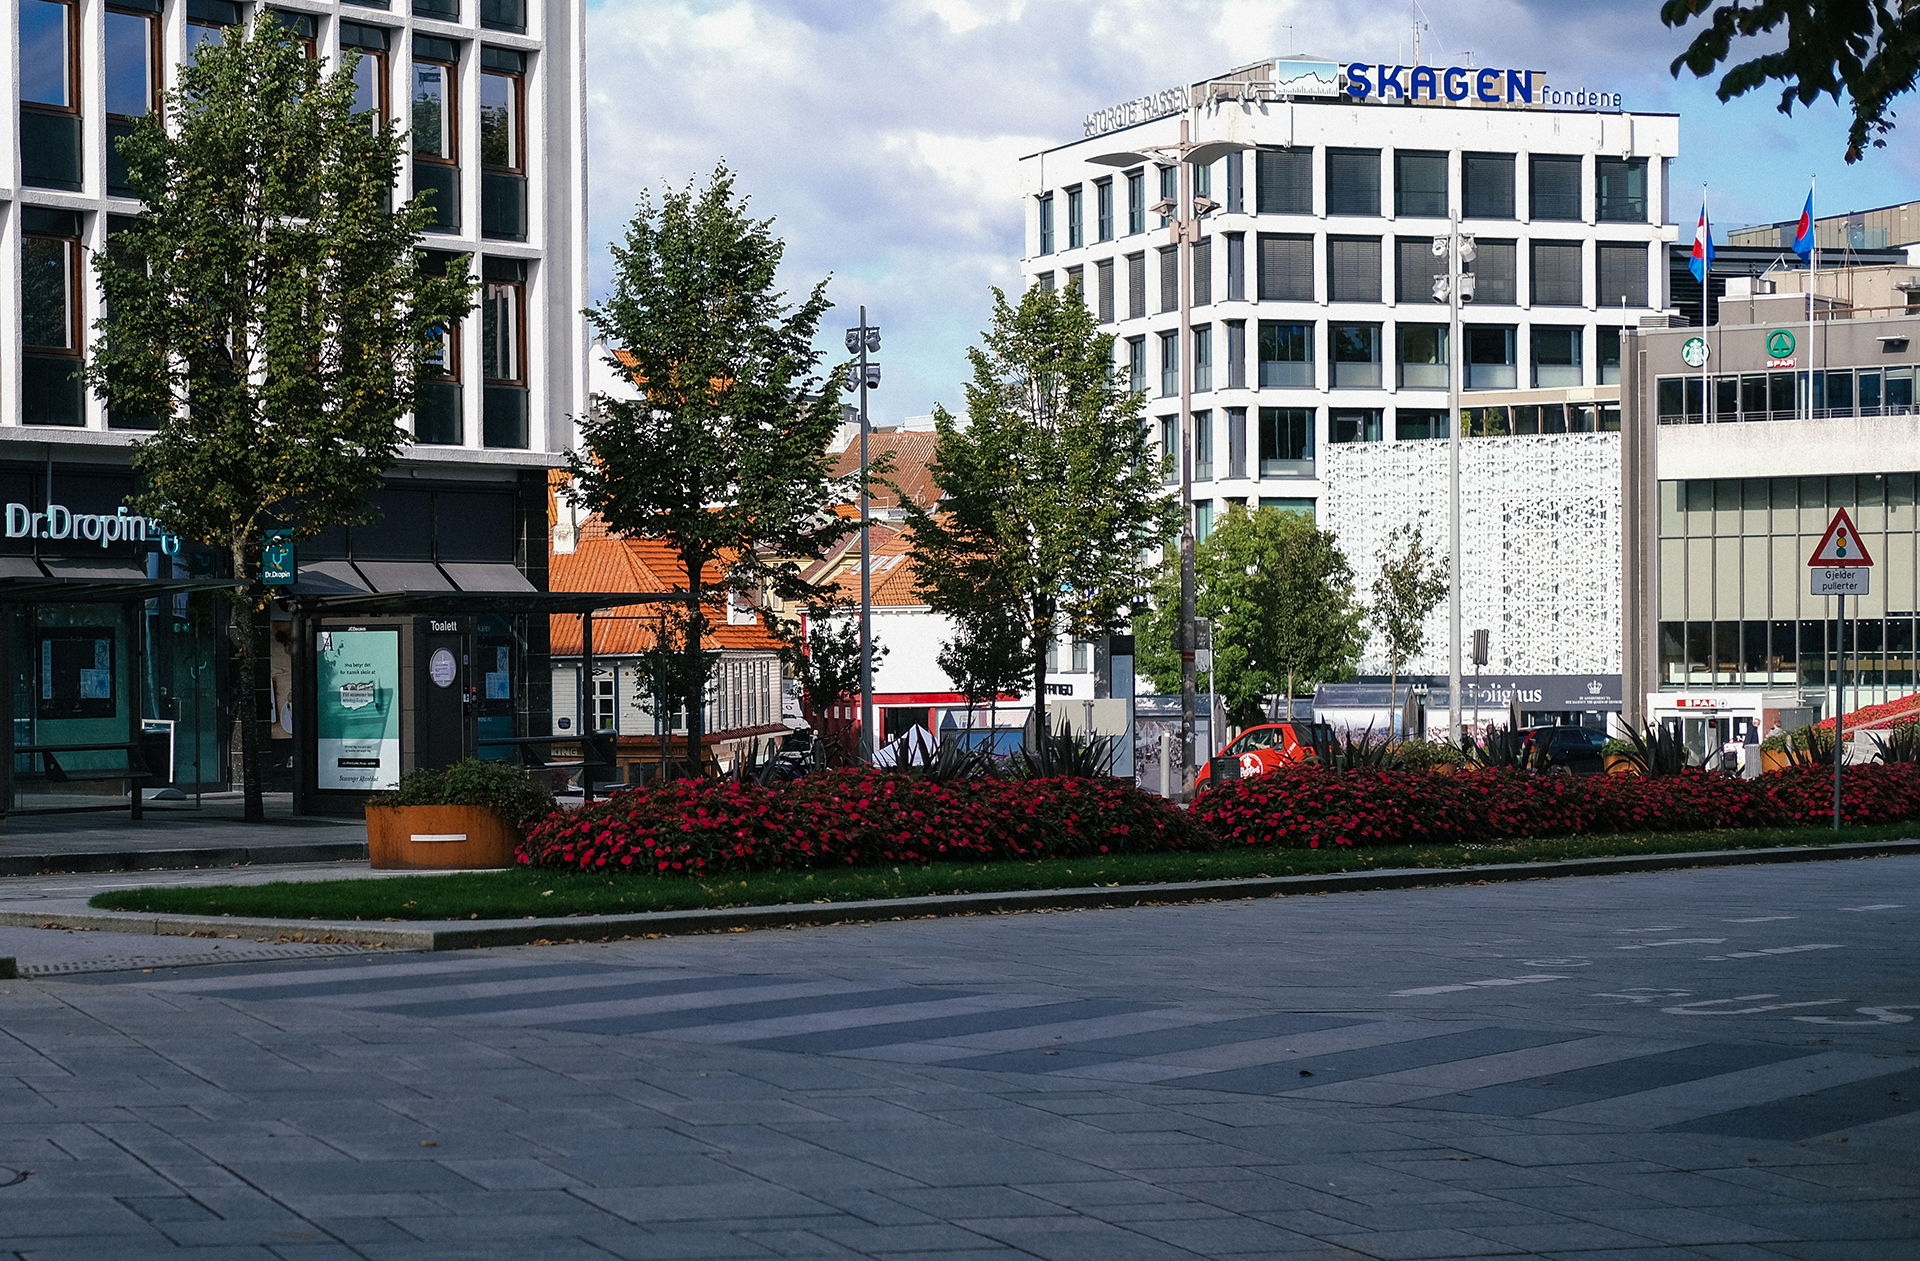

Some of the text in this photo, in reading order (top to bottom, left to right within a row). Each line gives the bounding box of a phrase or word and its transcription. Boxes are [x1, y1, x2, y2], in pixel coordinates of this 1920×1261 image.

[1346, 62, 1622, 107] SKAGEN fondene
[1766, 359, 1795, 367] SPAR
[5, 503, 146, 549] Dr.Dropin
[265, 570, 291, 579] Dr.Dropin
[1825, 570, 1856, 580] Gjelder
[1822, 582, 1858, 592] pullerter
[430, 620, 457, 631] Toalett
[1684, 699, 1717, 707] SPAR
